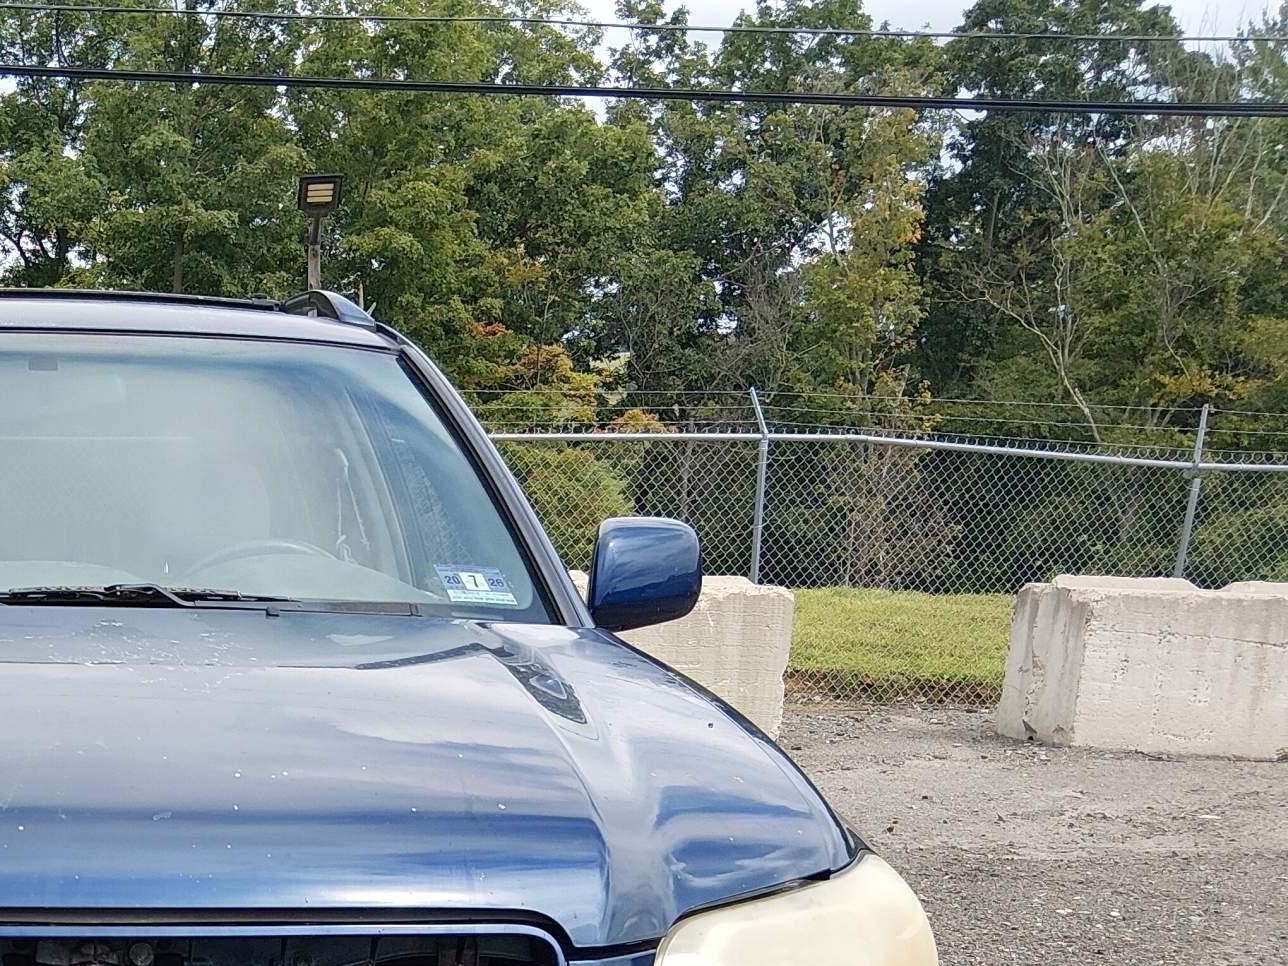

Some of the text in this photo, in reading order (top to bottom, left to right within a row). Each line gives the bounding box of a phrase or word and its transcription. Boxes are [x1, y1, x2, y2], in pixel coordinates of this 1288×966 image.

[444, 574, 504, 588] 20 7 26
